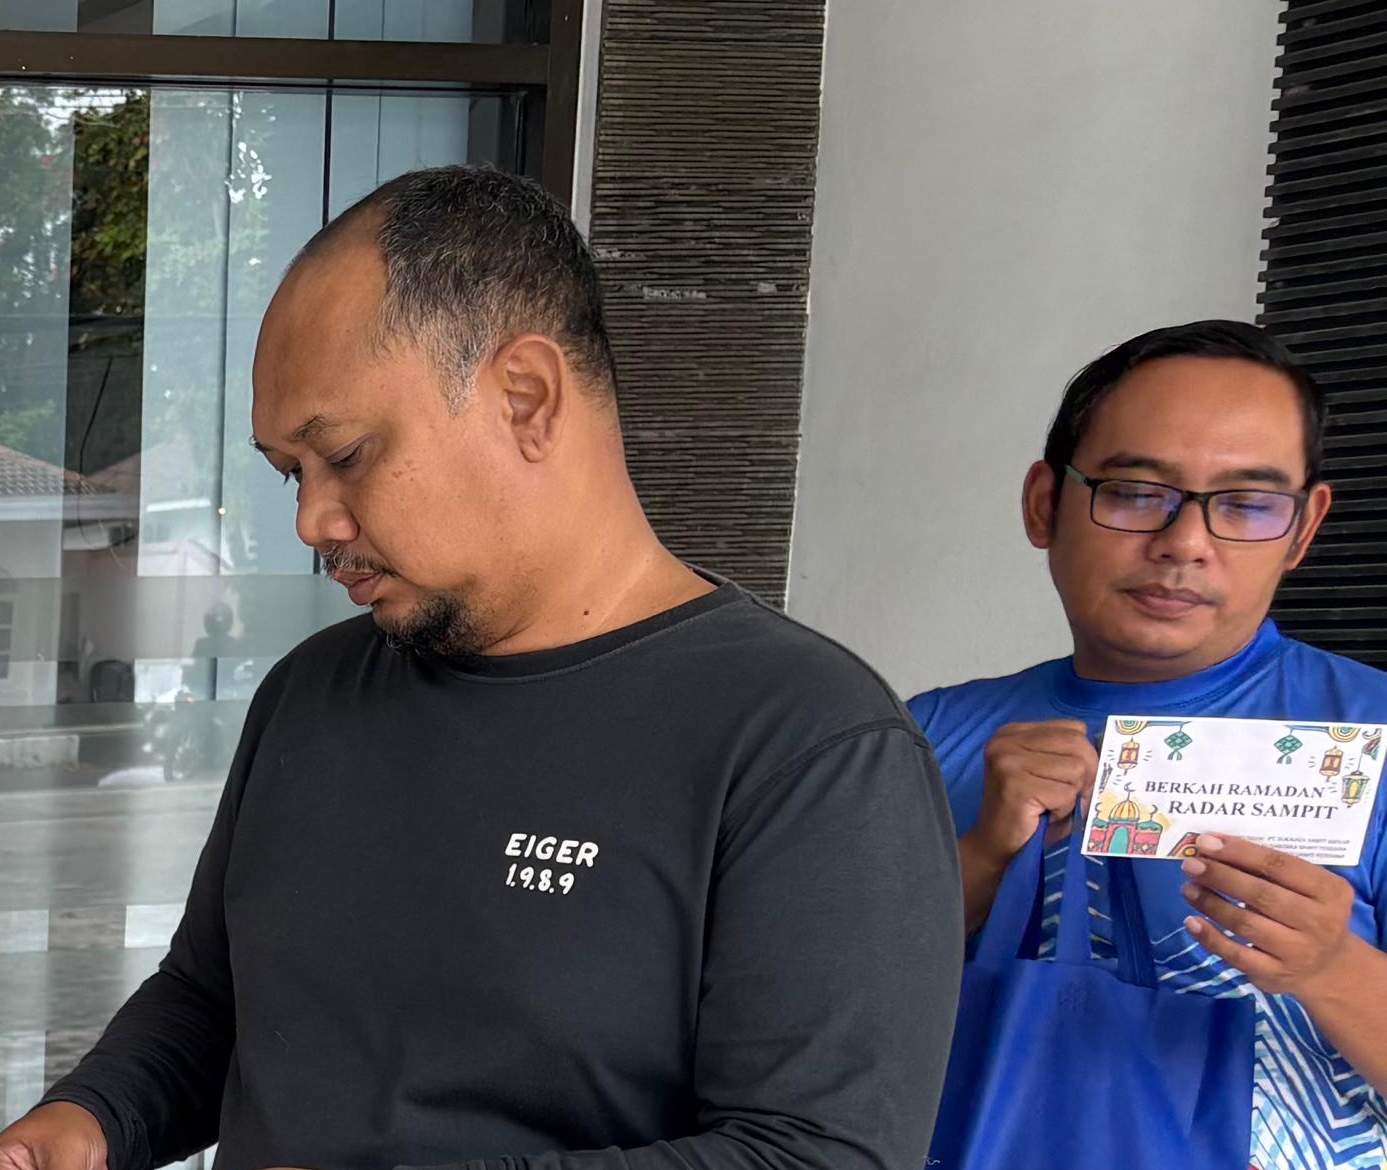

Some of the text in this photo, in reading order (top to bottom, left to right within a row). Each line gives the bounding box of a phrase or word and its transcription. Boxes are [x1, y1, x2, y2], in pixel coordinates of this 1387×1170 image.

[1144, 780, 1327, 799] BERKAH RAMADAN
[1167, 800, 1339, 820] RADAR SAMPIT
[505, 833, 599, 868] EIGER
[505, 863, 575, 895] 1.9.8.9
